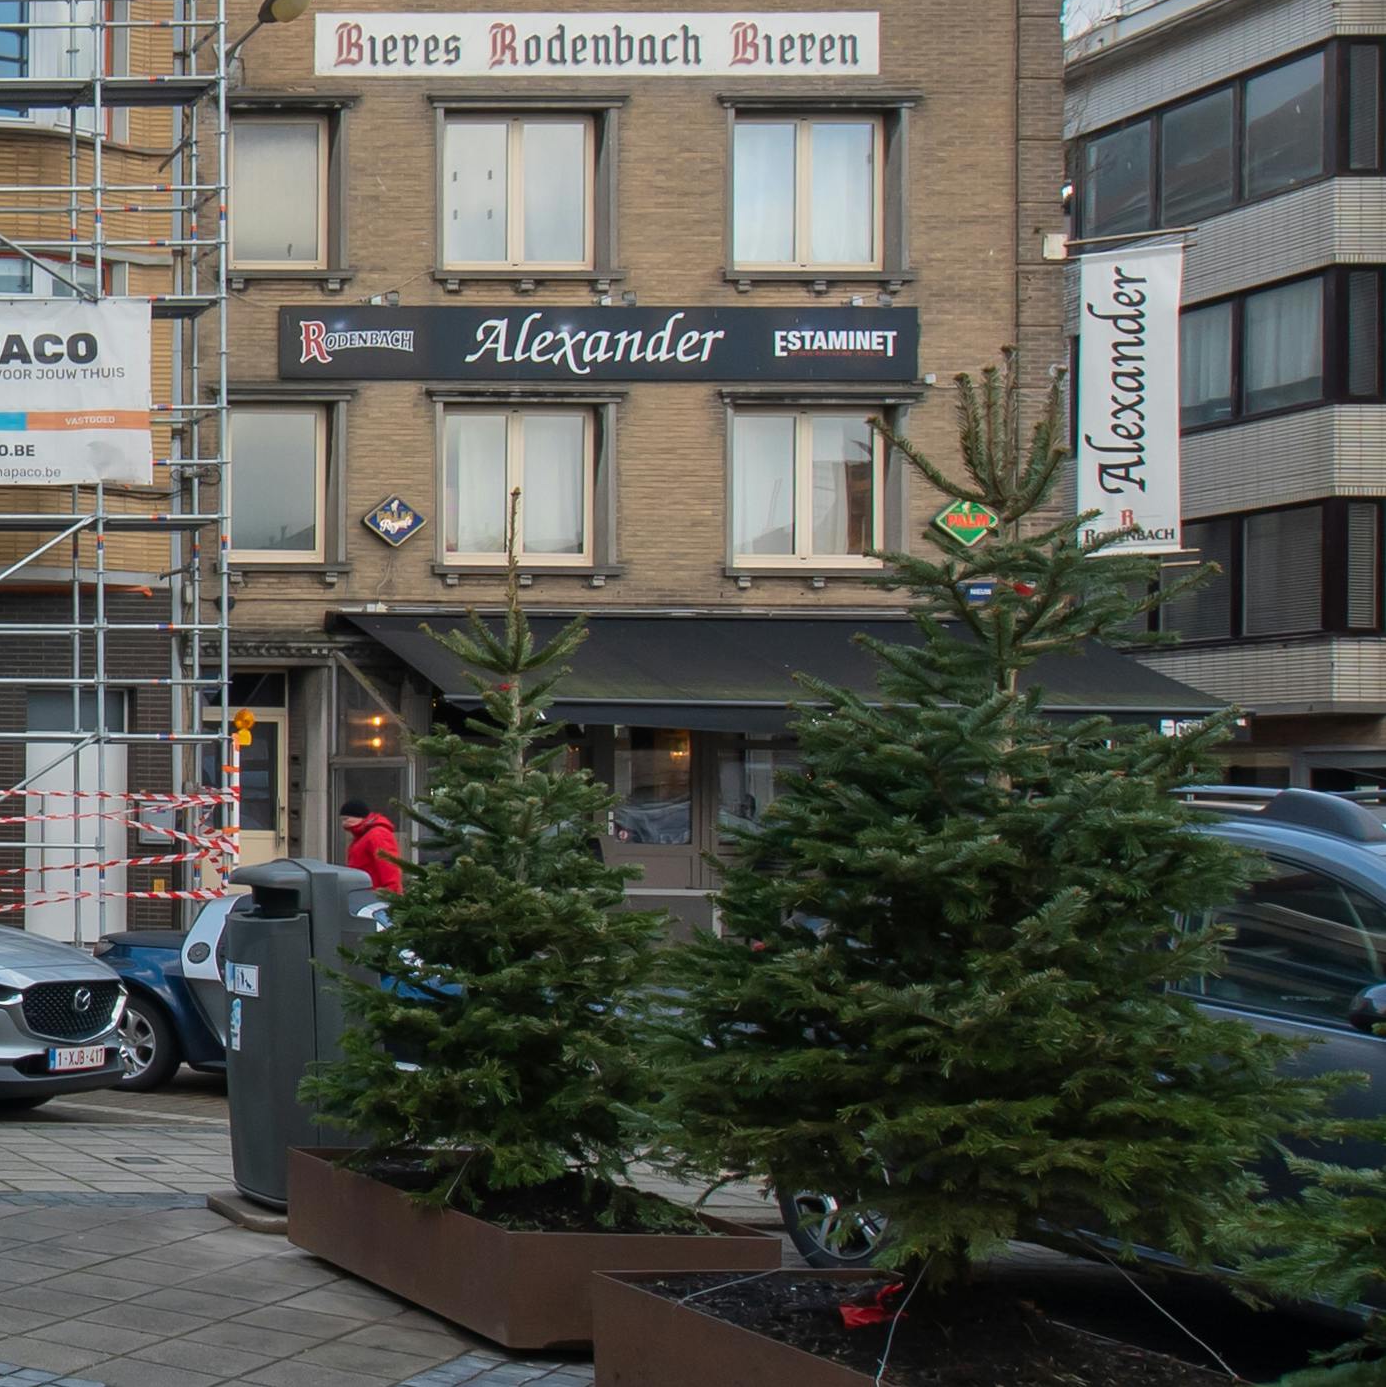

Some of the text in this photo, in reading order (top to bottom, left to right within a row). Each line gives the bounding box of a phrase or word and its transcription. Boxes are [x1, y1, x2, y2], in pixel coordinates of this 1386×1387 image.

[489, 22, 702, 69] Rodenbach
[464, 312, 725, 374] Alexander
[774, 330, 898, 357] ESTAMINET
[35, 368, 77, 380] JOUW
[81, 366, 125, 379] THUIS
[1084, 265, 1148, 494] Alexander
[65, 415, 116, 426] VASTGOED
[946, 513, 989, 528] PALM
[58, 1048, 103, 1067] 1-XJB-417
